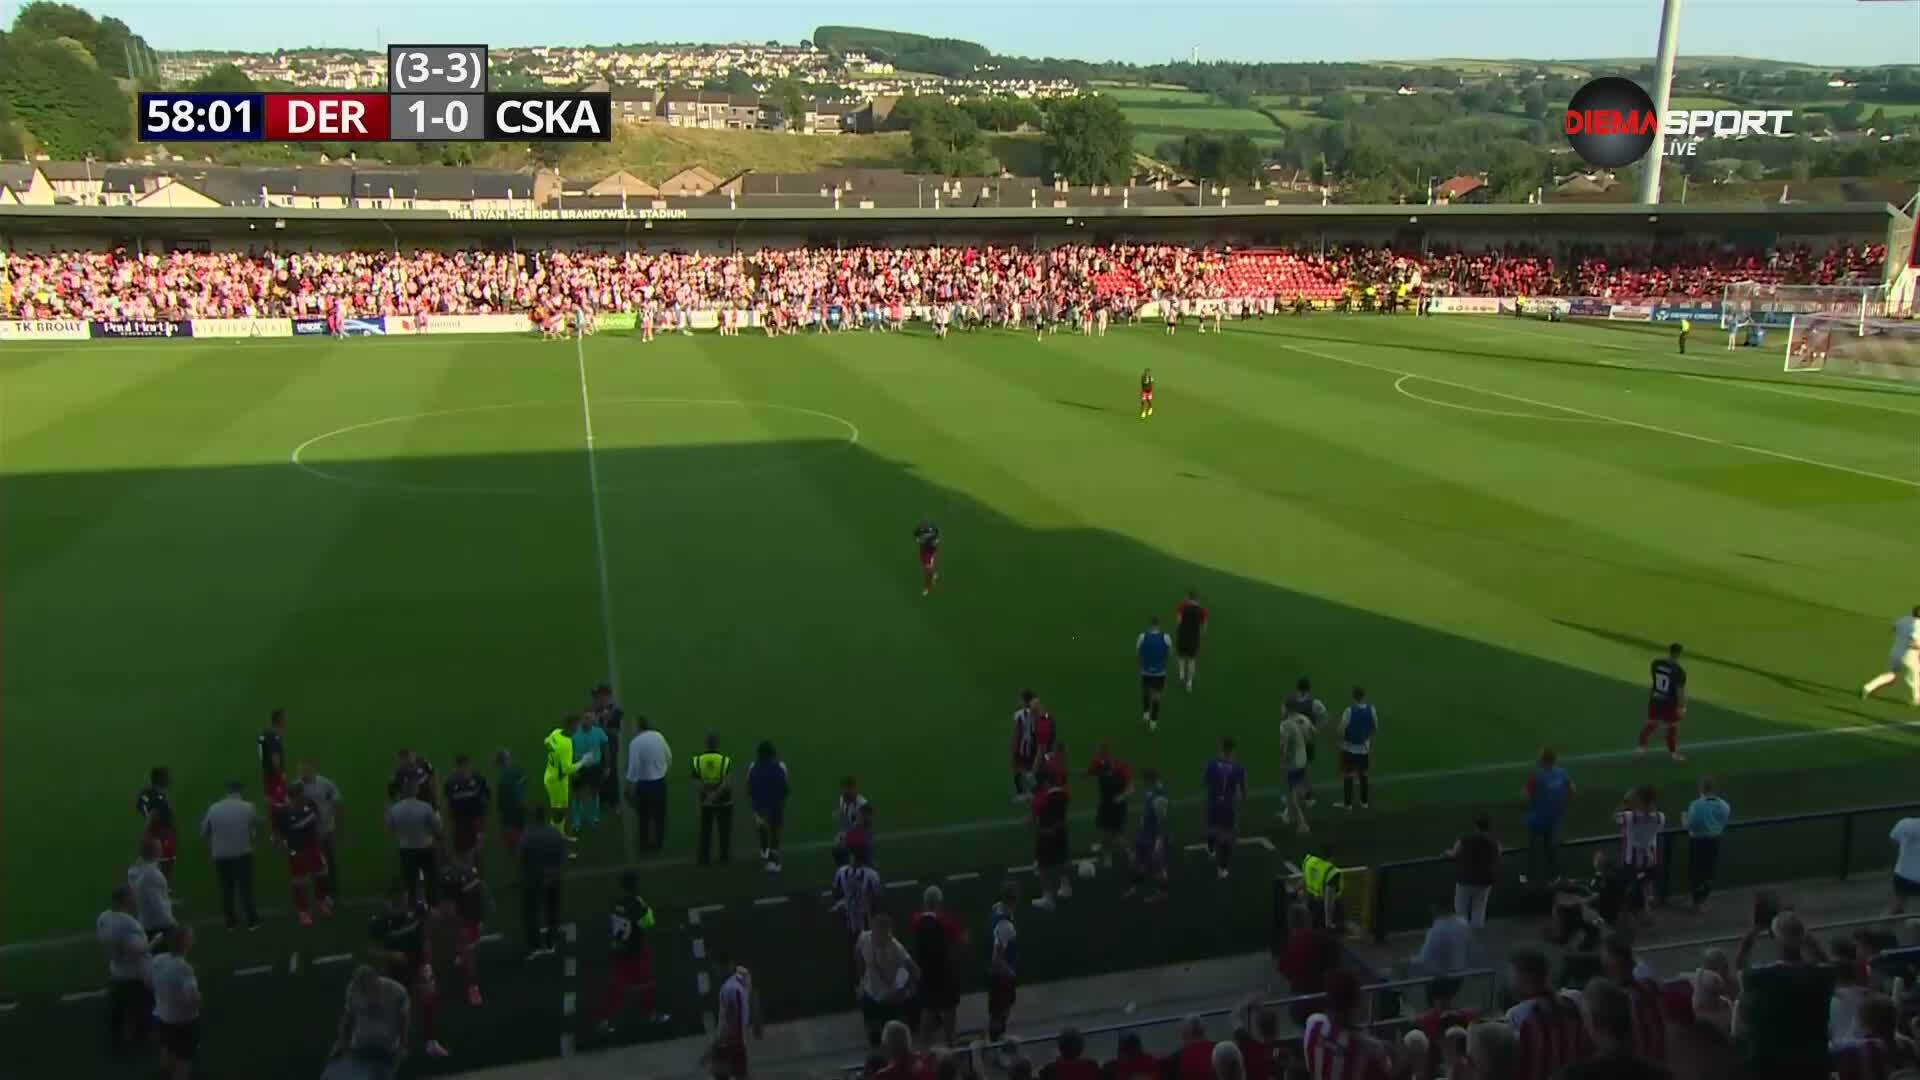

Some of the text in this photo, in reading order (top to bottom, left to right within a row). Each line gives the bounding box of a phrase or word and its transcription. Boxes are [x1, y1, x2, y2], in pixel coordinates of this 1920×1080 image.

[448, 209, 471, 219] THE
[474, 209, 504, 219] RYAN
[560, 209, 637, 219] BRANDYWELL
[639, 209, 687, 219] STADIUM
[1655, 673, 1670, 692] 10
